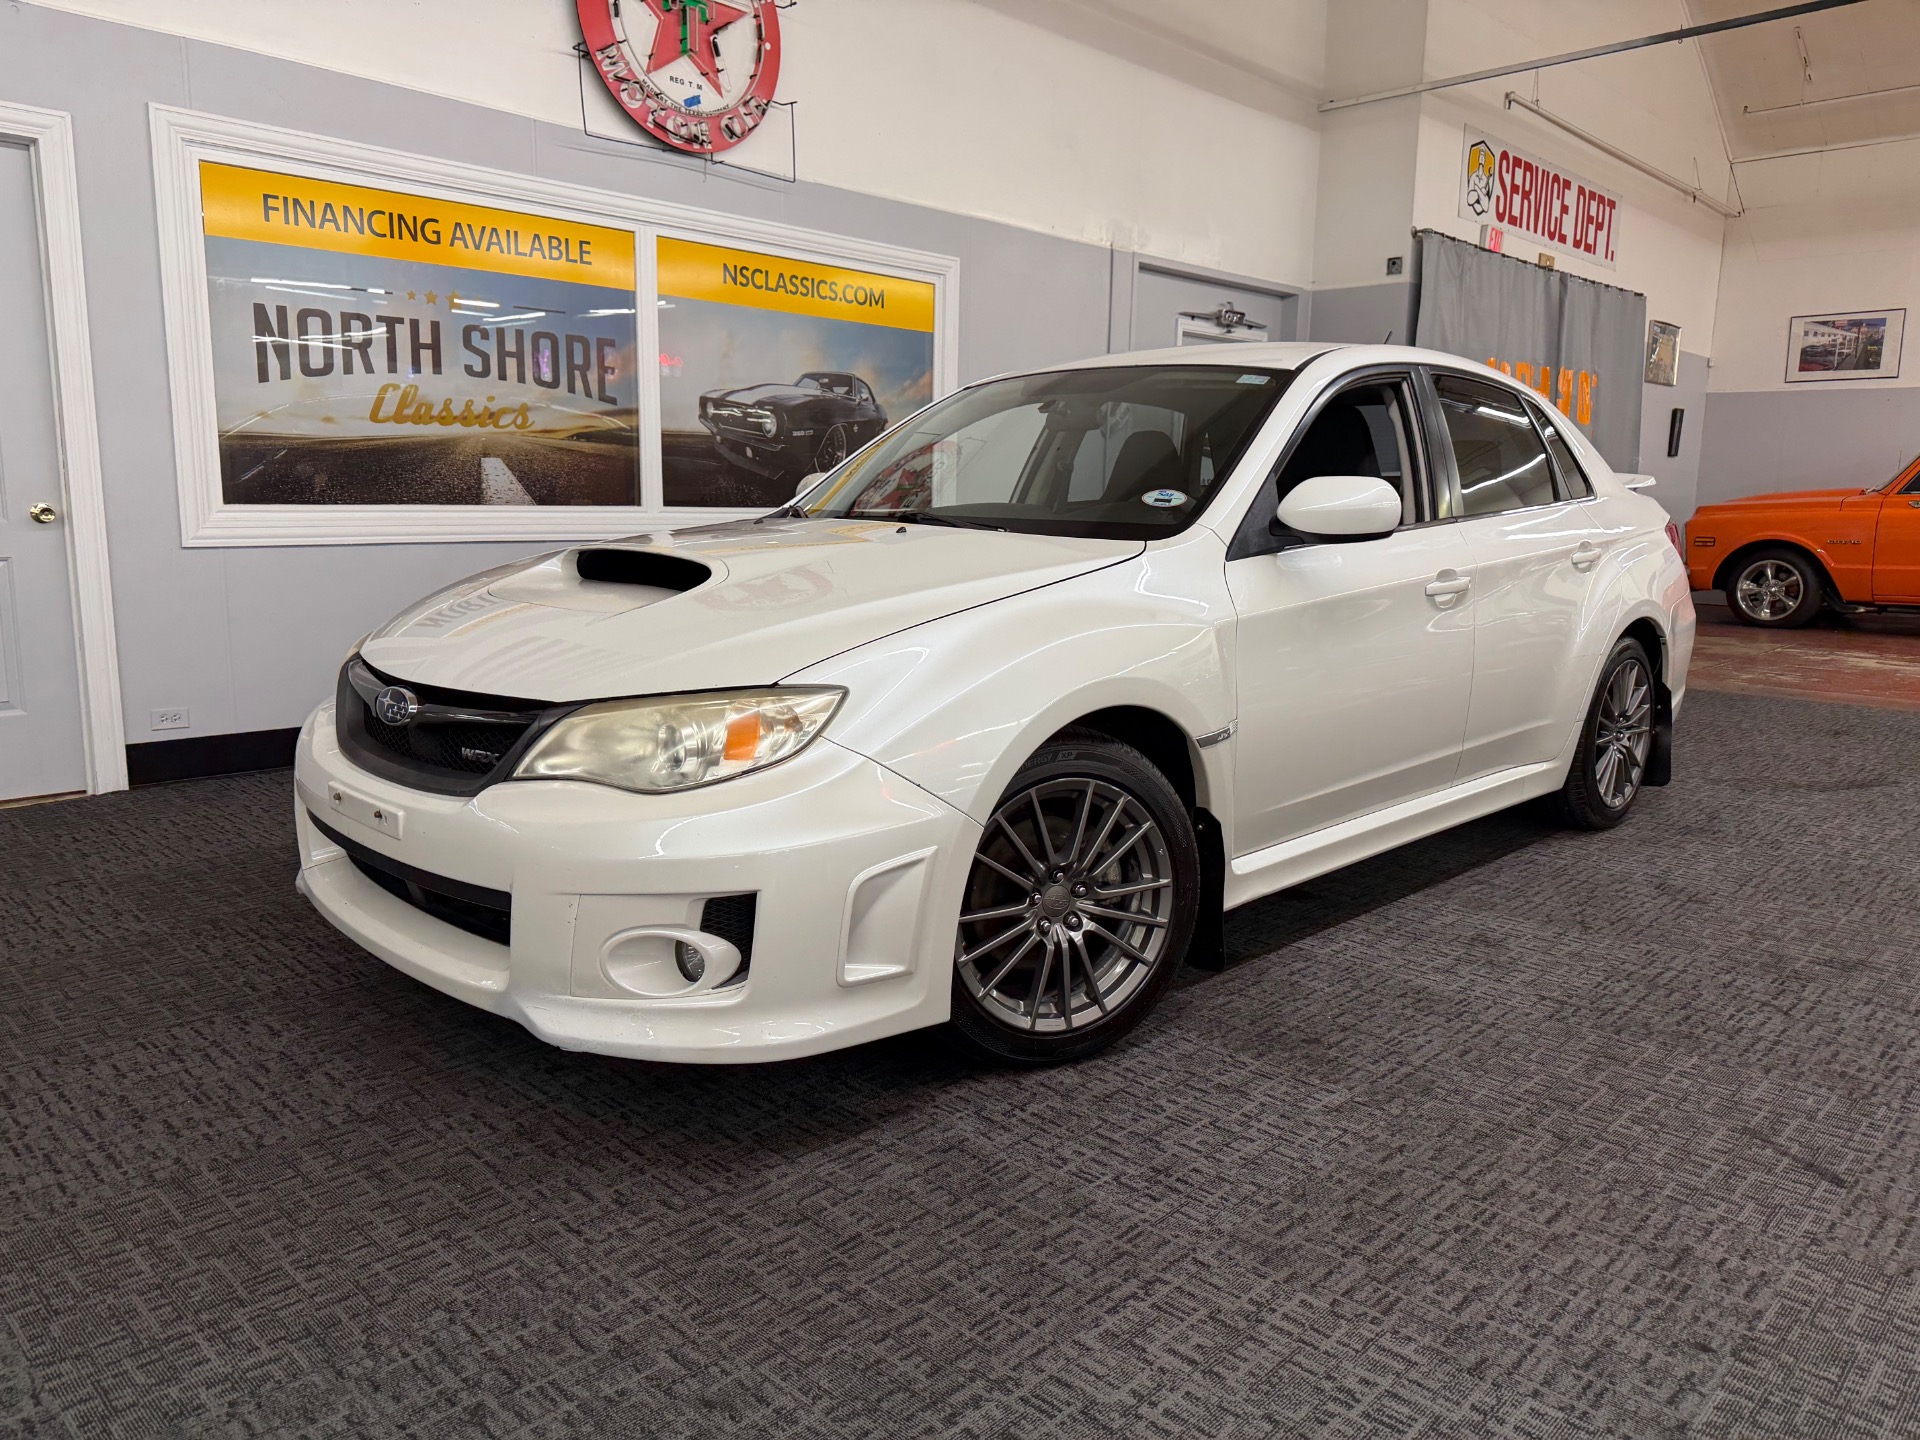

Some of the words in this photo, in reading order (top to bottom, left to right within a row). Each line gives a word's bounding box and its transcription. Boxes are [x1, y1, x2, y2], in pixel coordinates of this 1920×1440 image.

[595, 44, 713, 150] MOTOR
[261, 192, 442, 246] FINANCING
[448, 221, 593, 266] AVAILABLE
[1495, 149, 1572, 246] SERVICE
[1572, 185, 1617, 262] DEPT.
[722, 262, 885, 309] NSCLASSICS.COM
[252, 301, 443, 384] NORTH
[461, 323, 619, 407] SHORE
[368, 382, 535, 431] Classics
[461, 746, 500, 765] WRX
